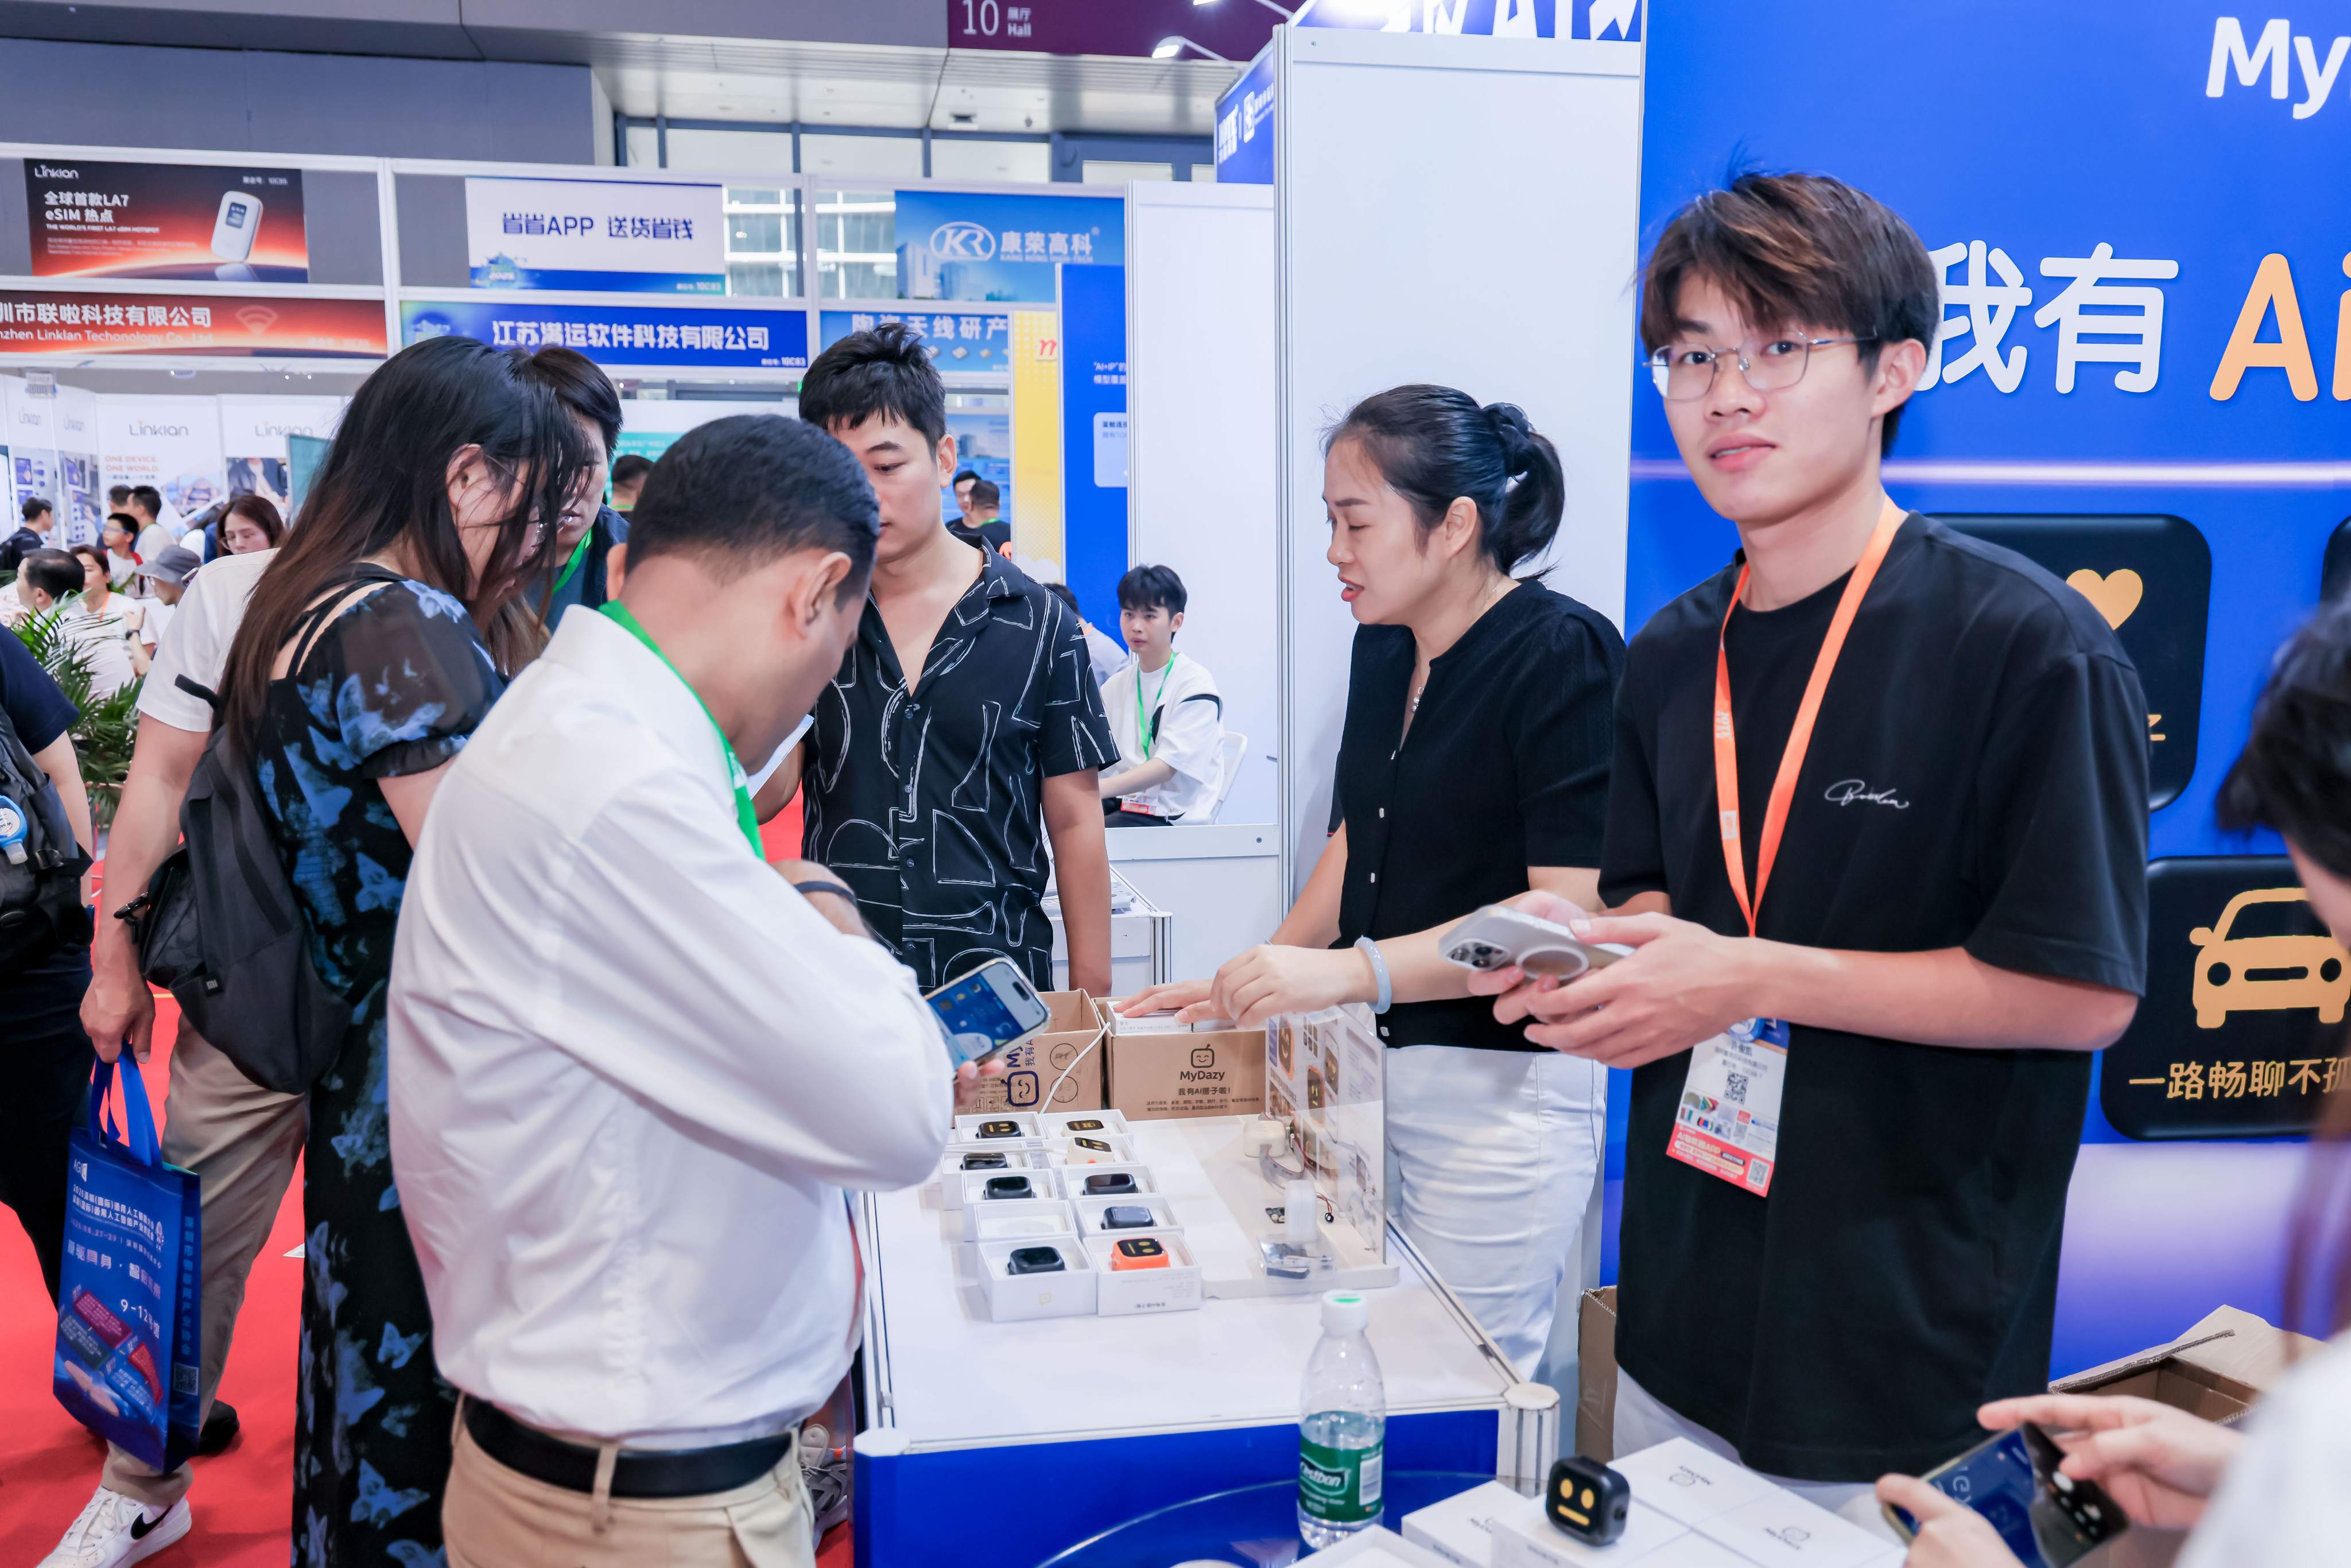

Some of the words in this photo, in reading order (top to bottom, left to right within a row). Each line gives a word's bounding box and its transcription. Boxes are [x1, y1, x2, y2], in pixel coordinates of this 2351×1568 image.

[963, 0, 999, 36] 10
[1008, 22, 1031, 37] Hall
[2206, 16, 2351, 119] My
[44, 191, 129, 207] 全球首款LA7
[45, 208, 81, 221] eSIM
[84, 208, 114, 223] 热点
[608, 216, 693, 239] 送货省钱
[1000, 231, 1092, 255] 康荣高科
[1912, 240, 2179, 394] 我有
[37, 329, 82, 341] Linklan
[1180, 1070, 1225, 1082] MyDazy
